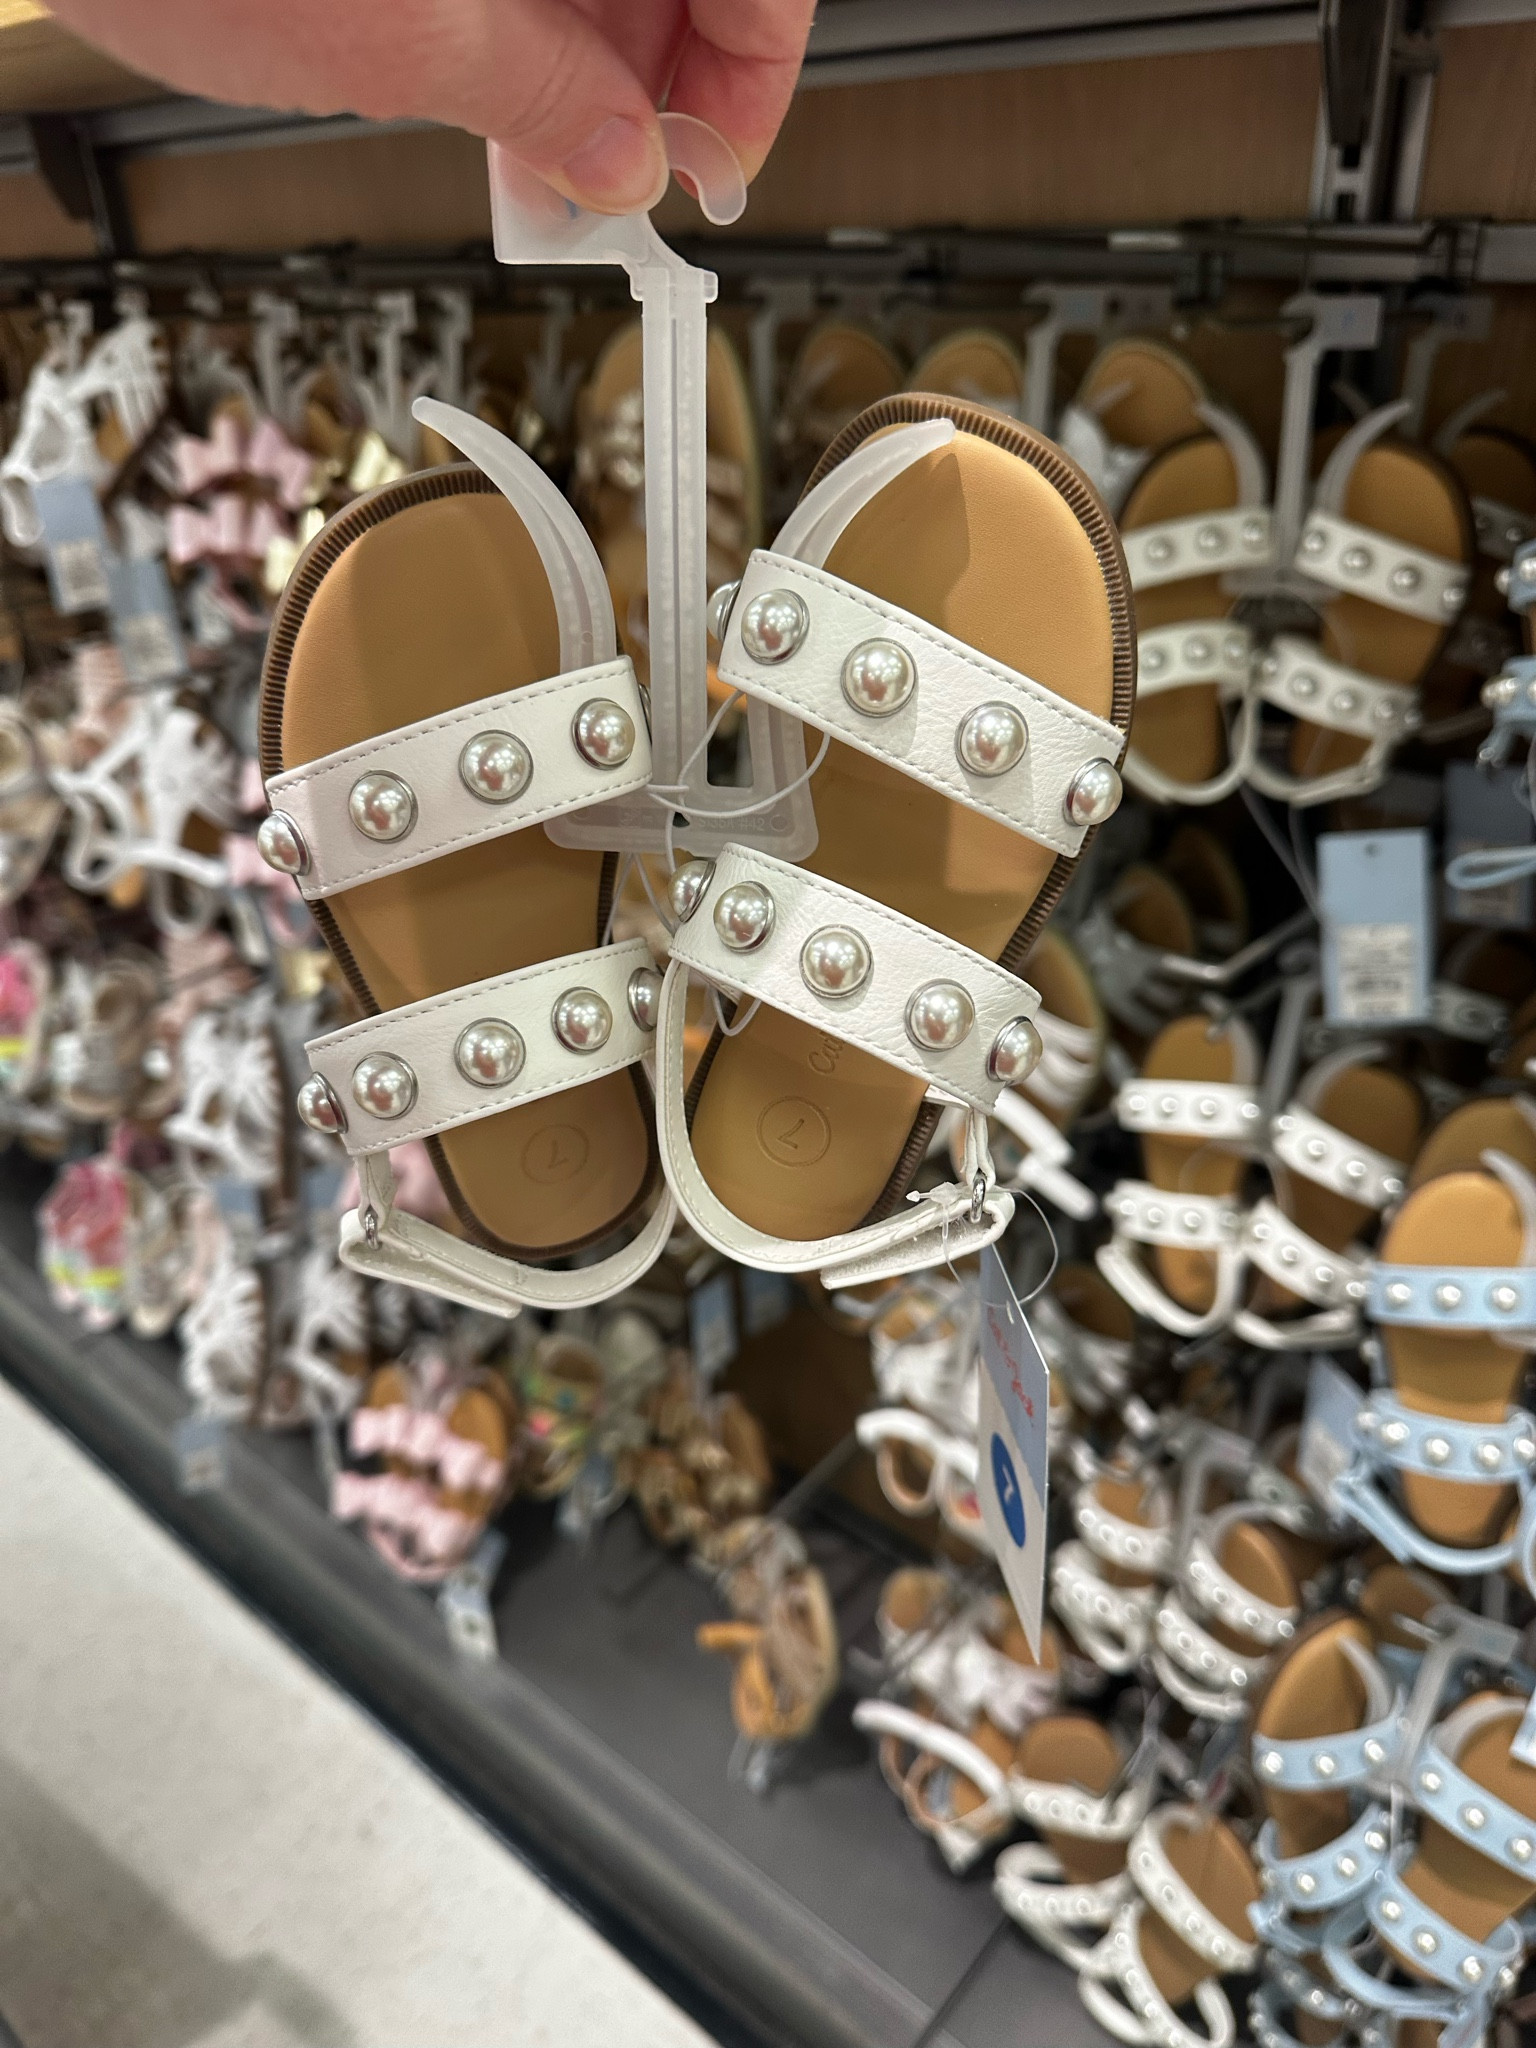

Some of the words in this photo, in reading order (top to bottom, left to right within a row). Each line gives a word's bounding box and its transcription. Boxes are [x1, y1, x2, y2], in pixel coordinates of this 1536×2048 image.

[776, 1118, 805, 1150] 7
[547, 1139, 570, 1170] 7
[1001, 1463, 1015, 1505] 7
